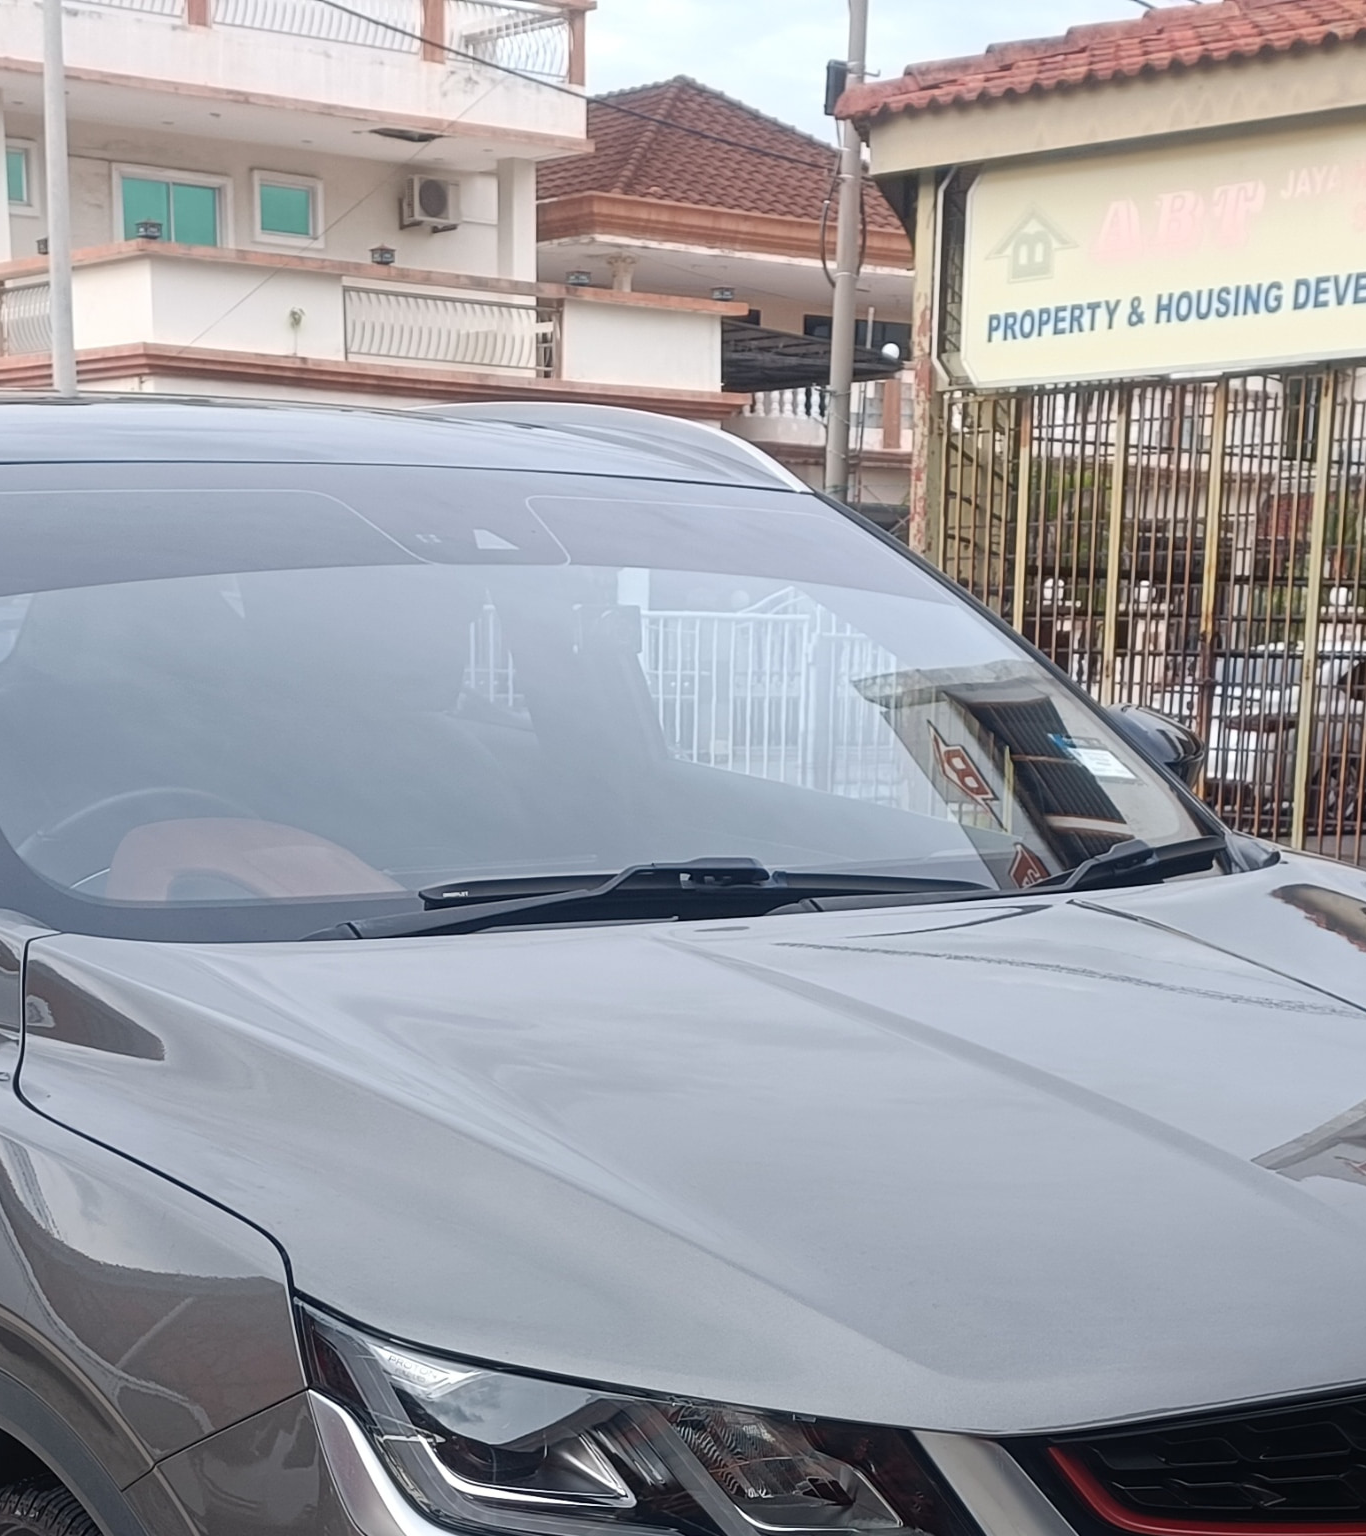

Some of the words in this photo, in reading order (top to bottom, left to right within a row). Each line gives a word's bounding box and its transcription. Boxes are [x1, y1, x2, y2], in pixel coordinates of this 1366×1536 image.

[1280, 164, 1341, 199] JAYA
[986, 298, 1122, 344] PROPERTY
[1127, 295, 1146, 328] &
[1155, 281, 1283, 326] HOUSING
